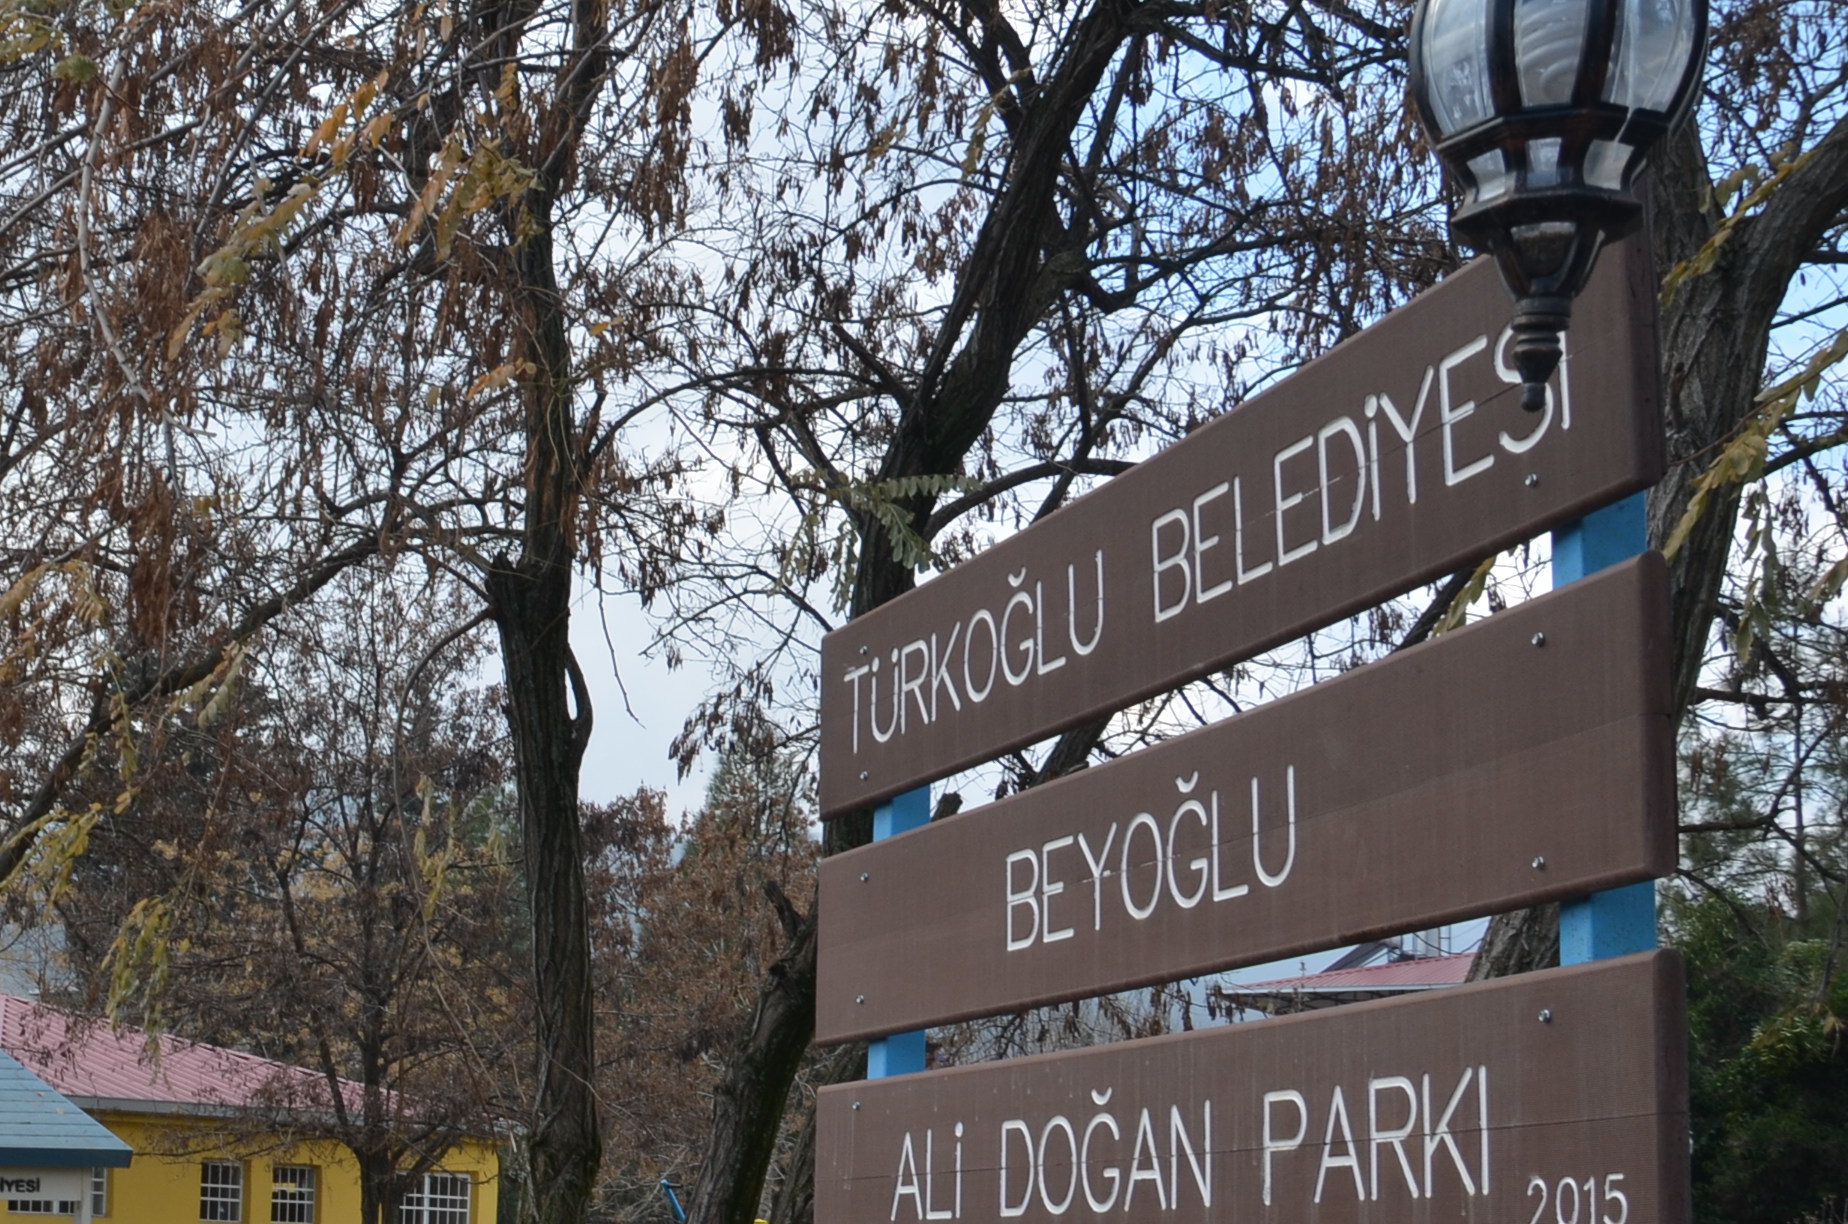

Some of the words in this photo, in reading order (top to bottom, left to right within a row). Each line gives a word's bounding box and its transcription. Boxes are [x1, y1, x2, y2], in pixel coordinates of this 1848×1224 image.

[843, 549, 1105, 754] TÜRKOĞLU
[1005, 765, 1295, 952] BEYOĞLU
[890, 1122, 964, 1222] ALİ
[998, 1088, 1213, 1219] DOĞAN
[1262, 1064, 1490, 1207] PARKI
